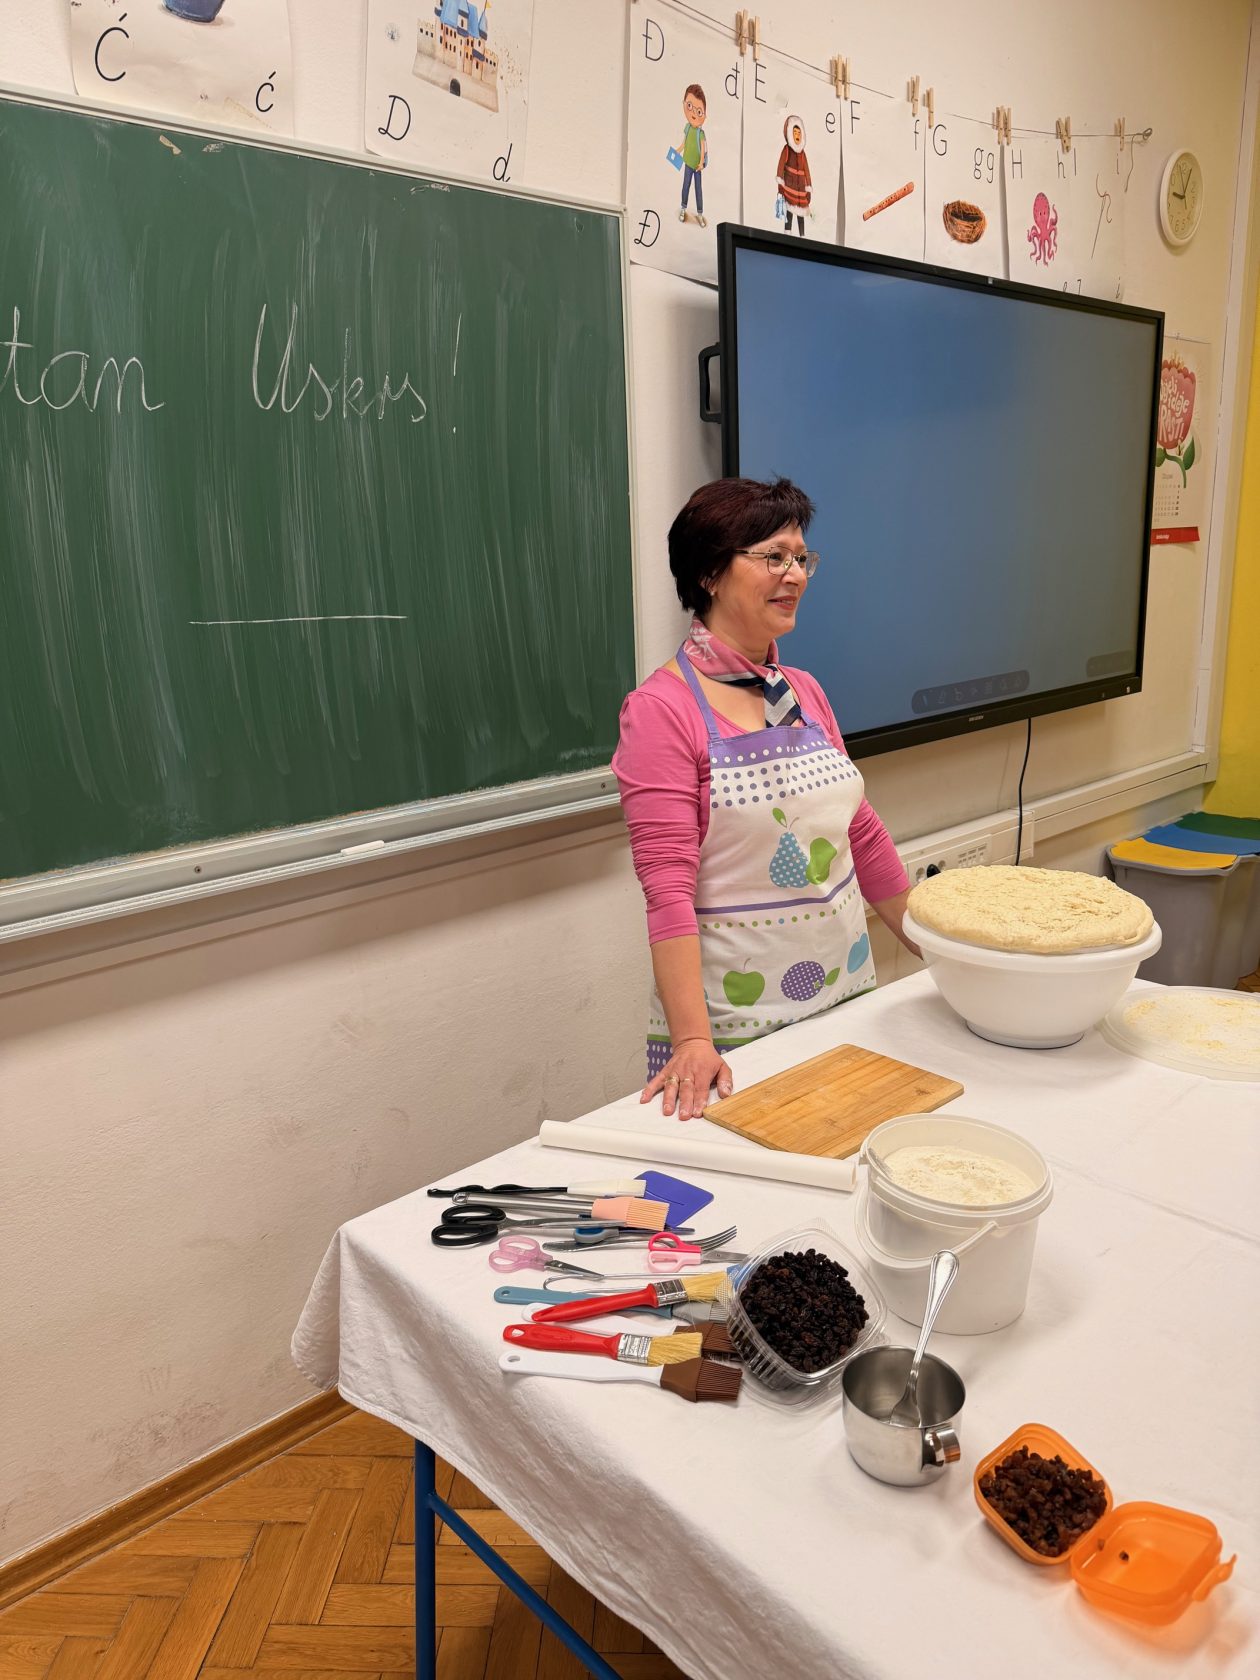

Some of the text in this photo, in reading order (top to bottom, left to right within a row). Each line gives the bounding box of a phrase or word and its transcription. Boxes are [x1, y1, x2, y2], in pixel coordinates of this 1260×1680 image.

[95, 13, 129, 82] Ć
[642, 18, 665, 62] Đ
[256, 71, 276, 112] ć
[755, 62, 836, 133] E e
[378, 95, 411, 140] D
[850, 100, 920, 150] F f
[933, 124, 948, 156] G
[493, 143, 512, 182] d
[1011, 149, 1023, 179] H
